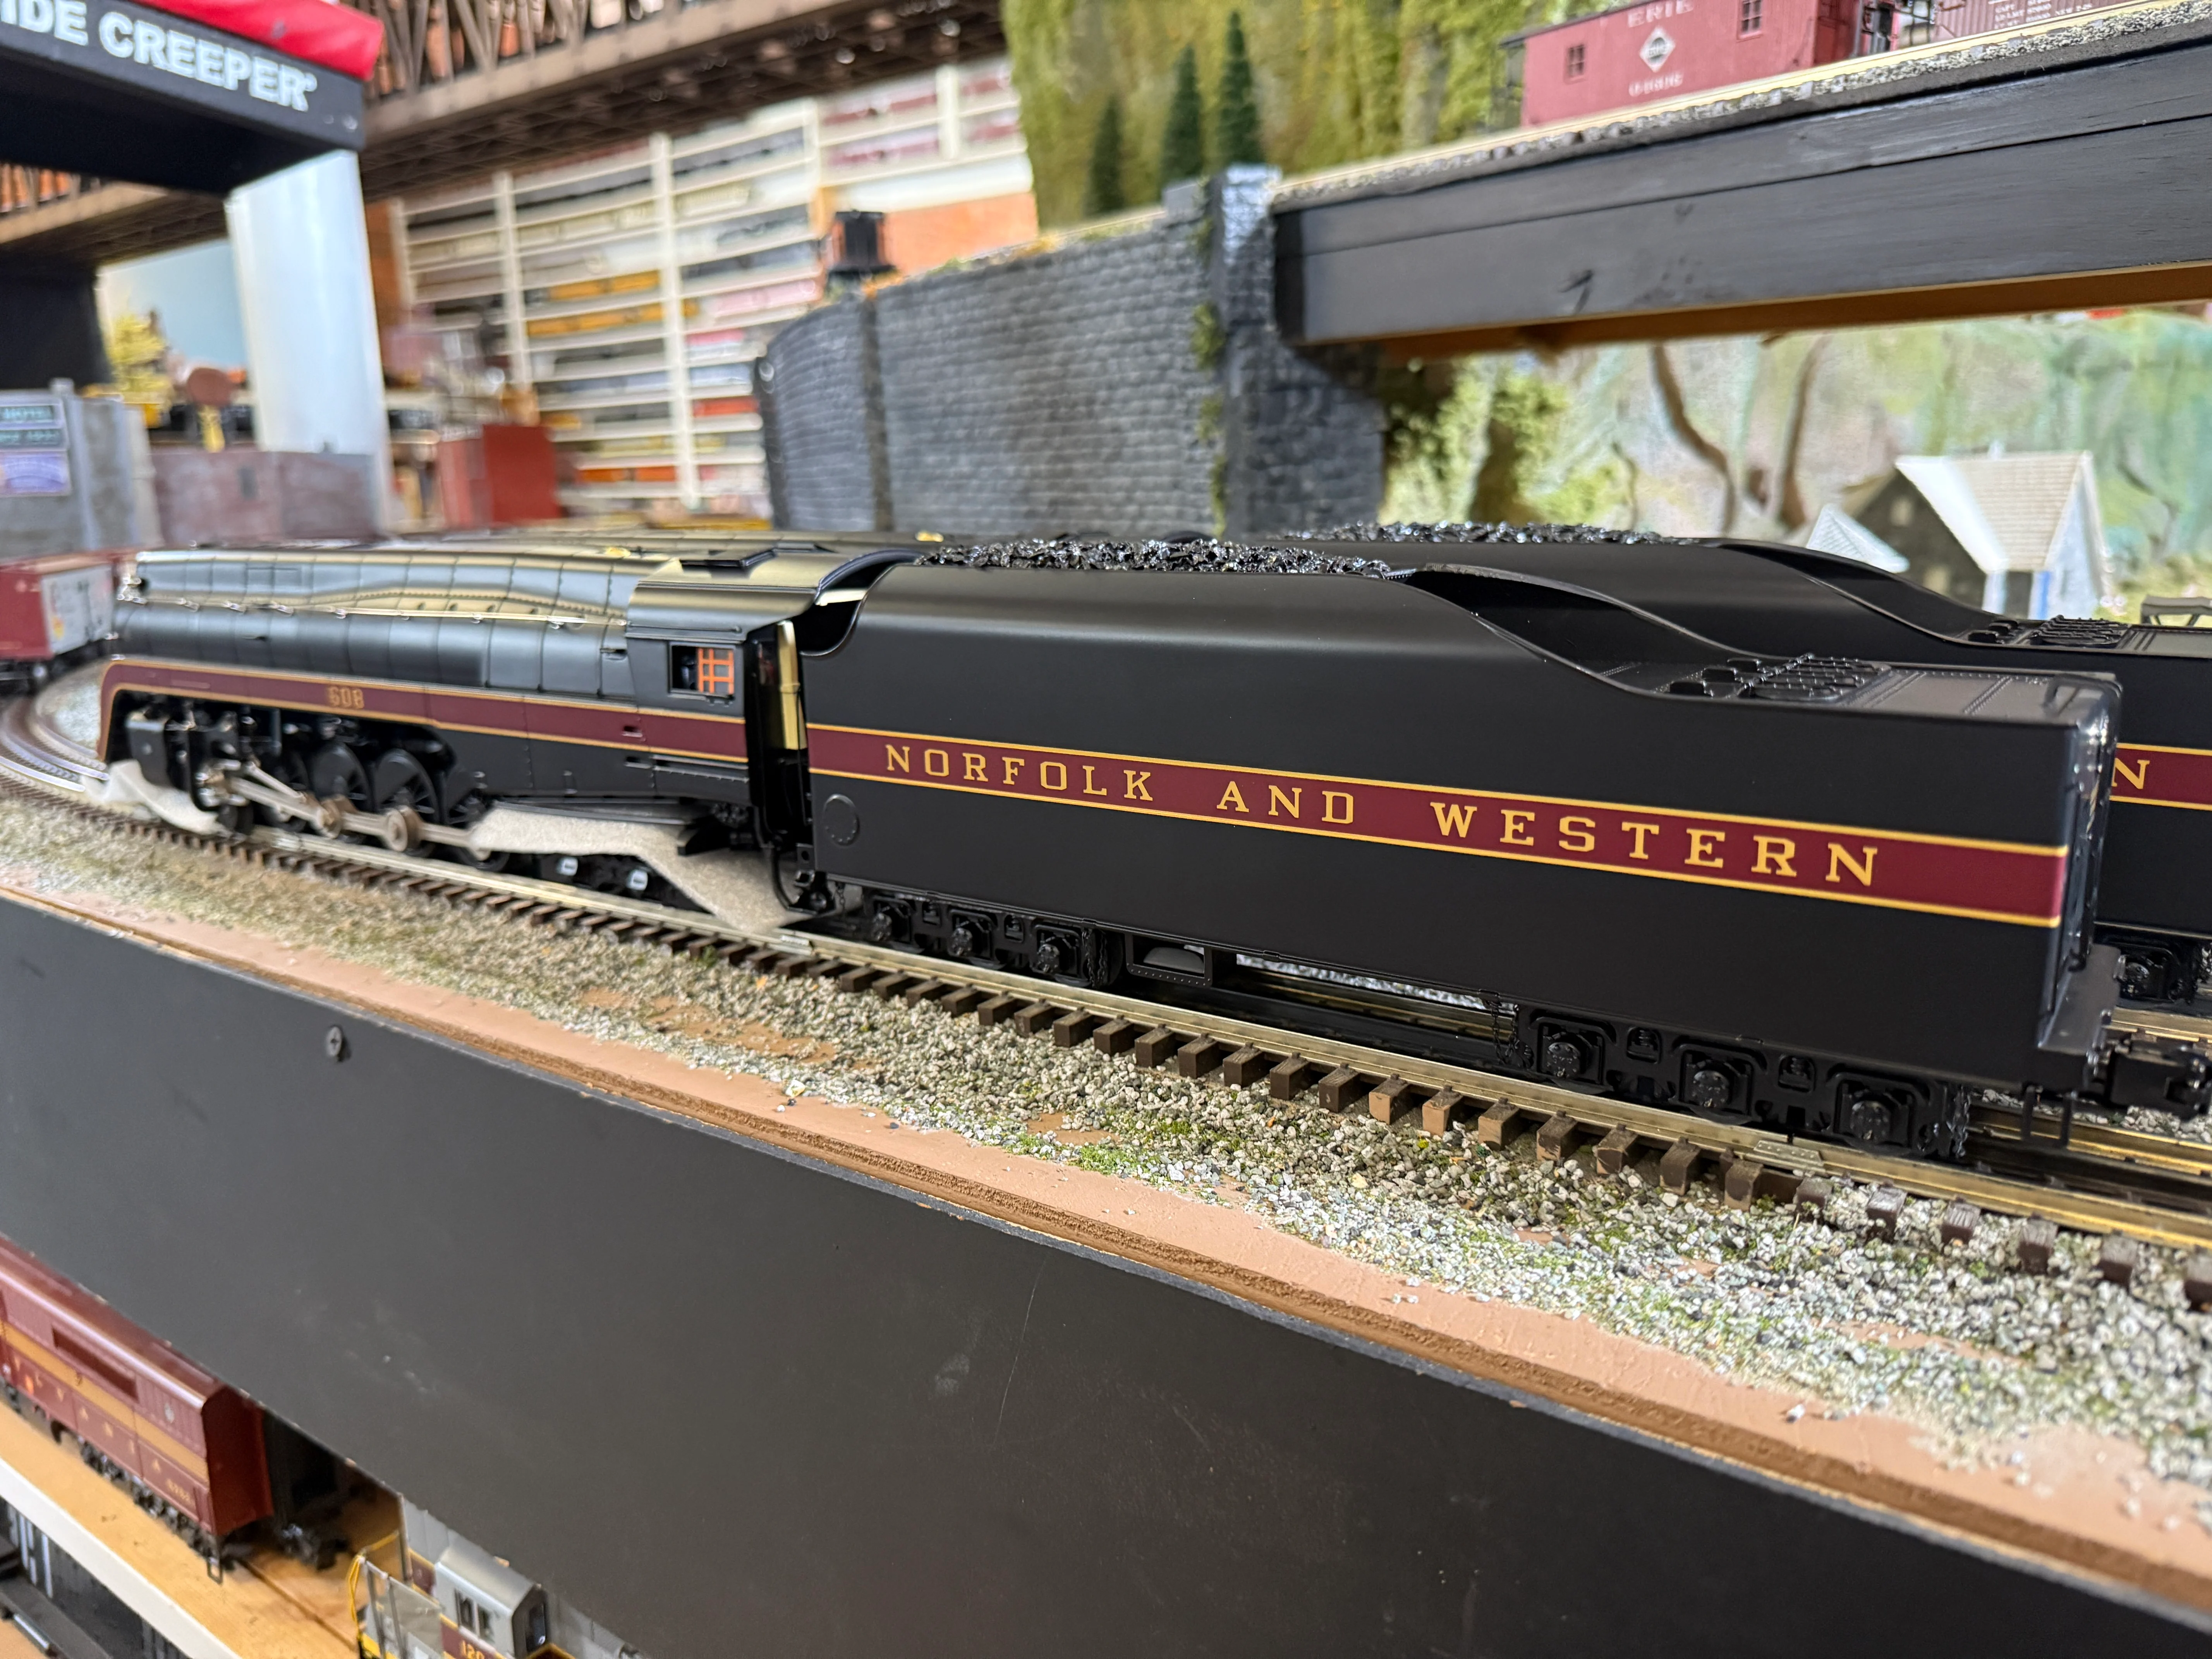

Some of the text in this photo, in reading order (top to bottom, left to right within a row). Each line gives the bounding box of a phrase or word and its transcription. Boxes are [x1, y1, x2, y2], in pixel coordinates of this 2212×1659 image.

[1628, 0, 1694, 27] ERIE
[328, 686, 364, 709] 608
[2111, 757, 2150, 789] N
[886, 744, 1878, 886] NORFOLK AND WESTERN
